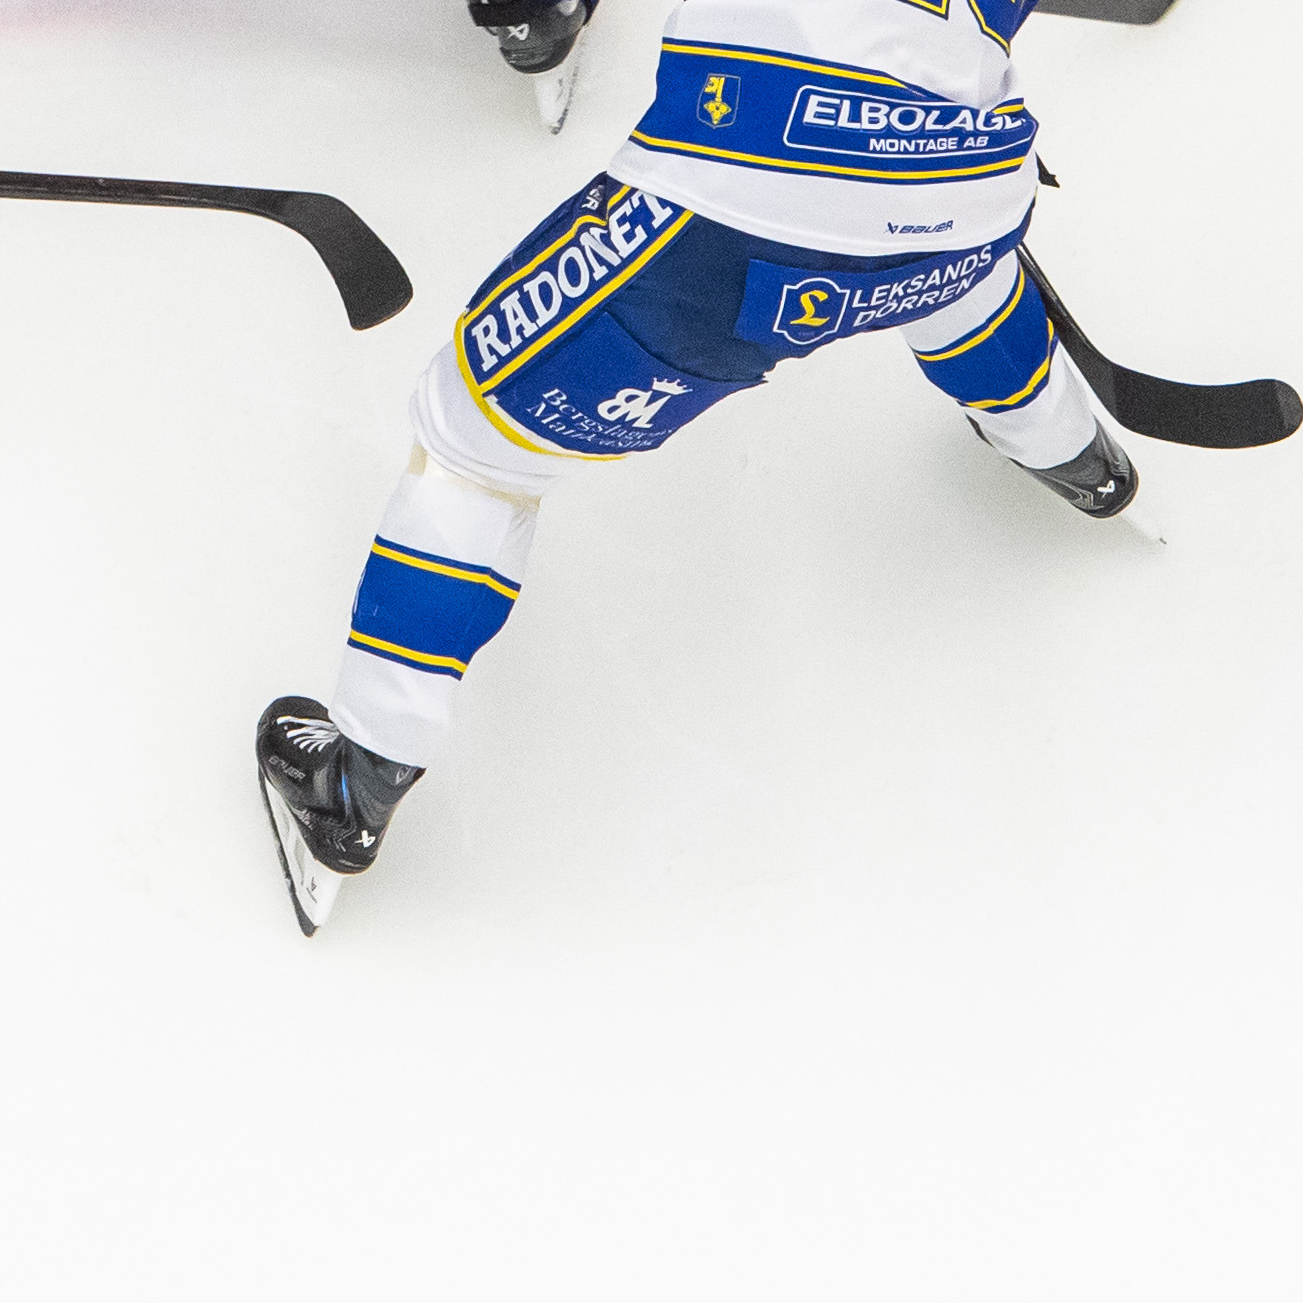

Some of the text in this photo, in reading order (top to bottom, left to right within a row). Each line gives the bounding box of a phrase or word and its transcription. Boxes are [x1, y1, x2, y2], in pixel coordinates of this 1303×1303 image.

[869, 136, 990, 153] MONTAGE AB
[897, 220, 954, 234] BAUER
[851, 244, 993, 309] LEKSANDS
